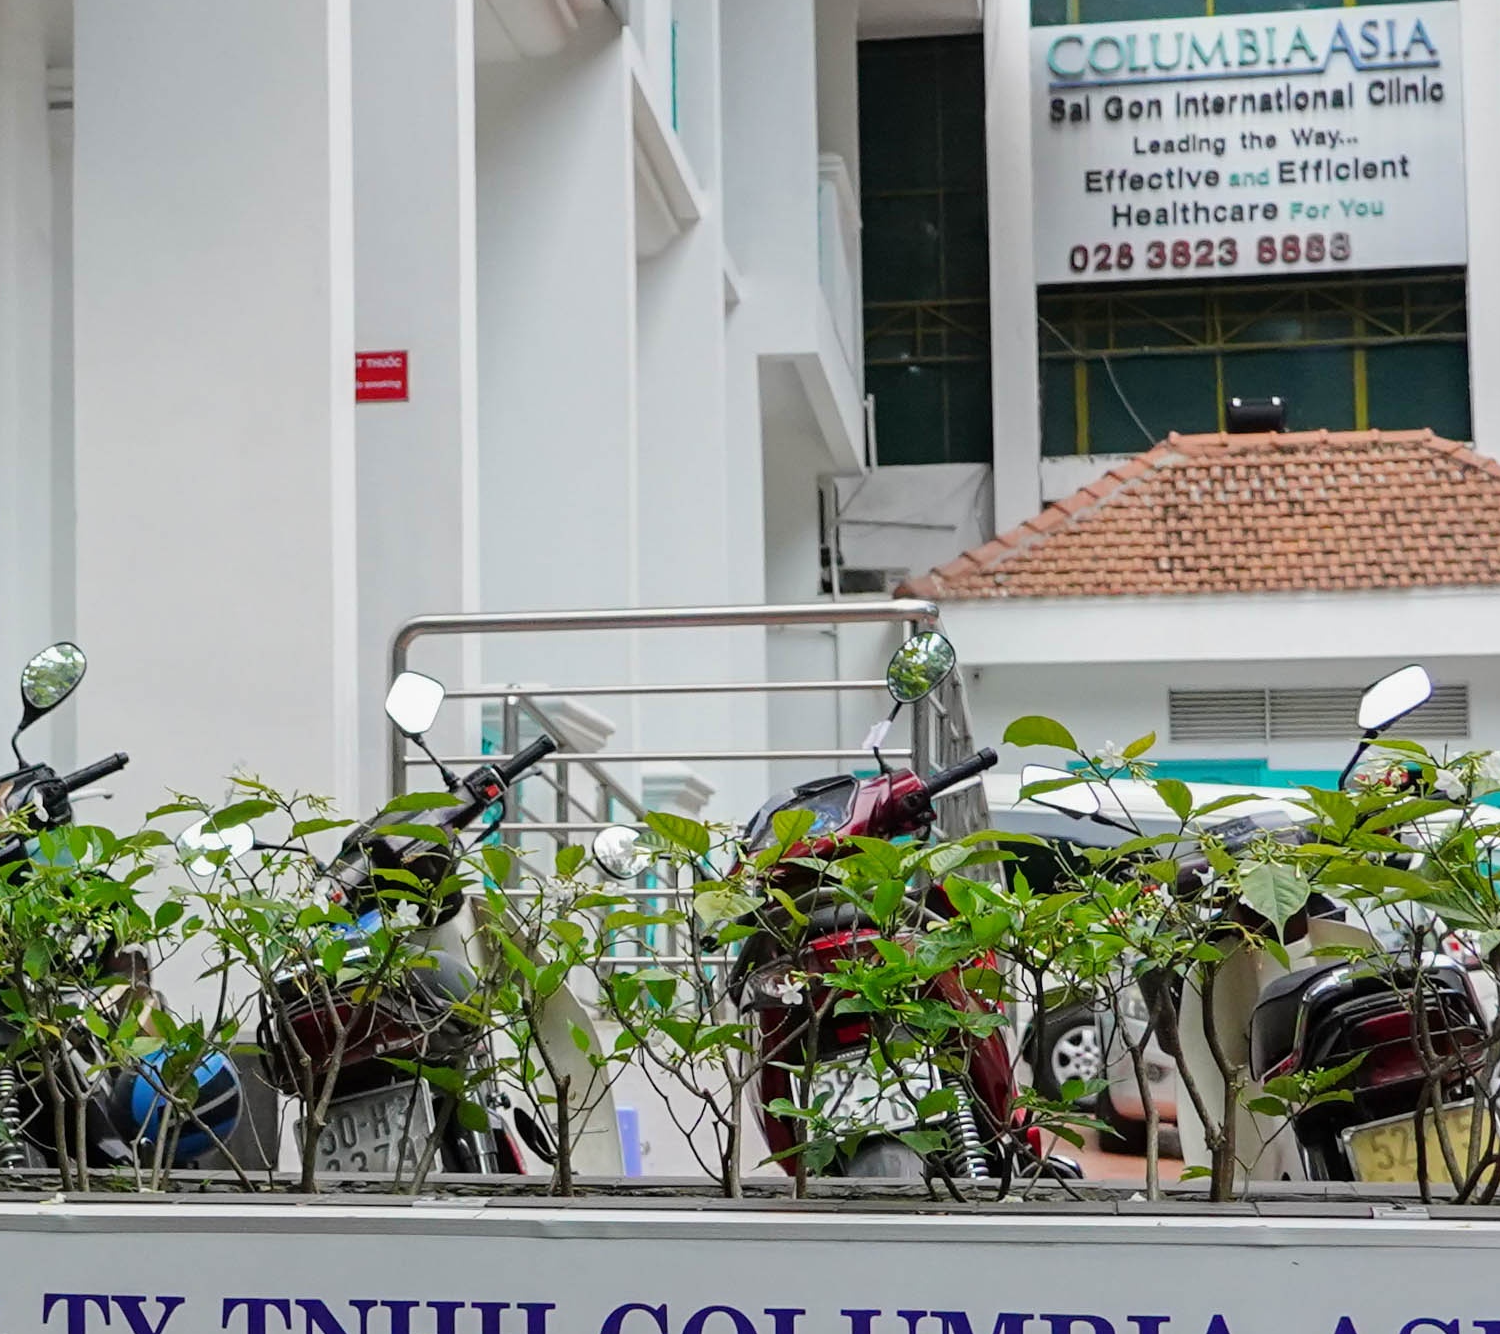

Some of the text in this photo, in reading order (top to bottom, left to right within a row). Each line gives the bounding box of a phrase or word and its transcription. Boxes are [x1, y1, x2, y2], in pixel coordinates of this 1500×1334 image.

[1048, 77, 1444, 122] Sai Gon International Clinic
[1134, 133, 1226, 155] Leading
[1241, 130, 1277, 150] the
[1084, 155, 1410, 193] Effective and Efficient
[1112, 197, 1384, 229] Healthcare For You
[1070, 244, 1134, 272] 028
[1146, 239, 1238, 269] 3823
